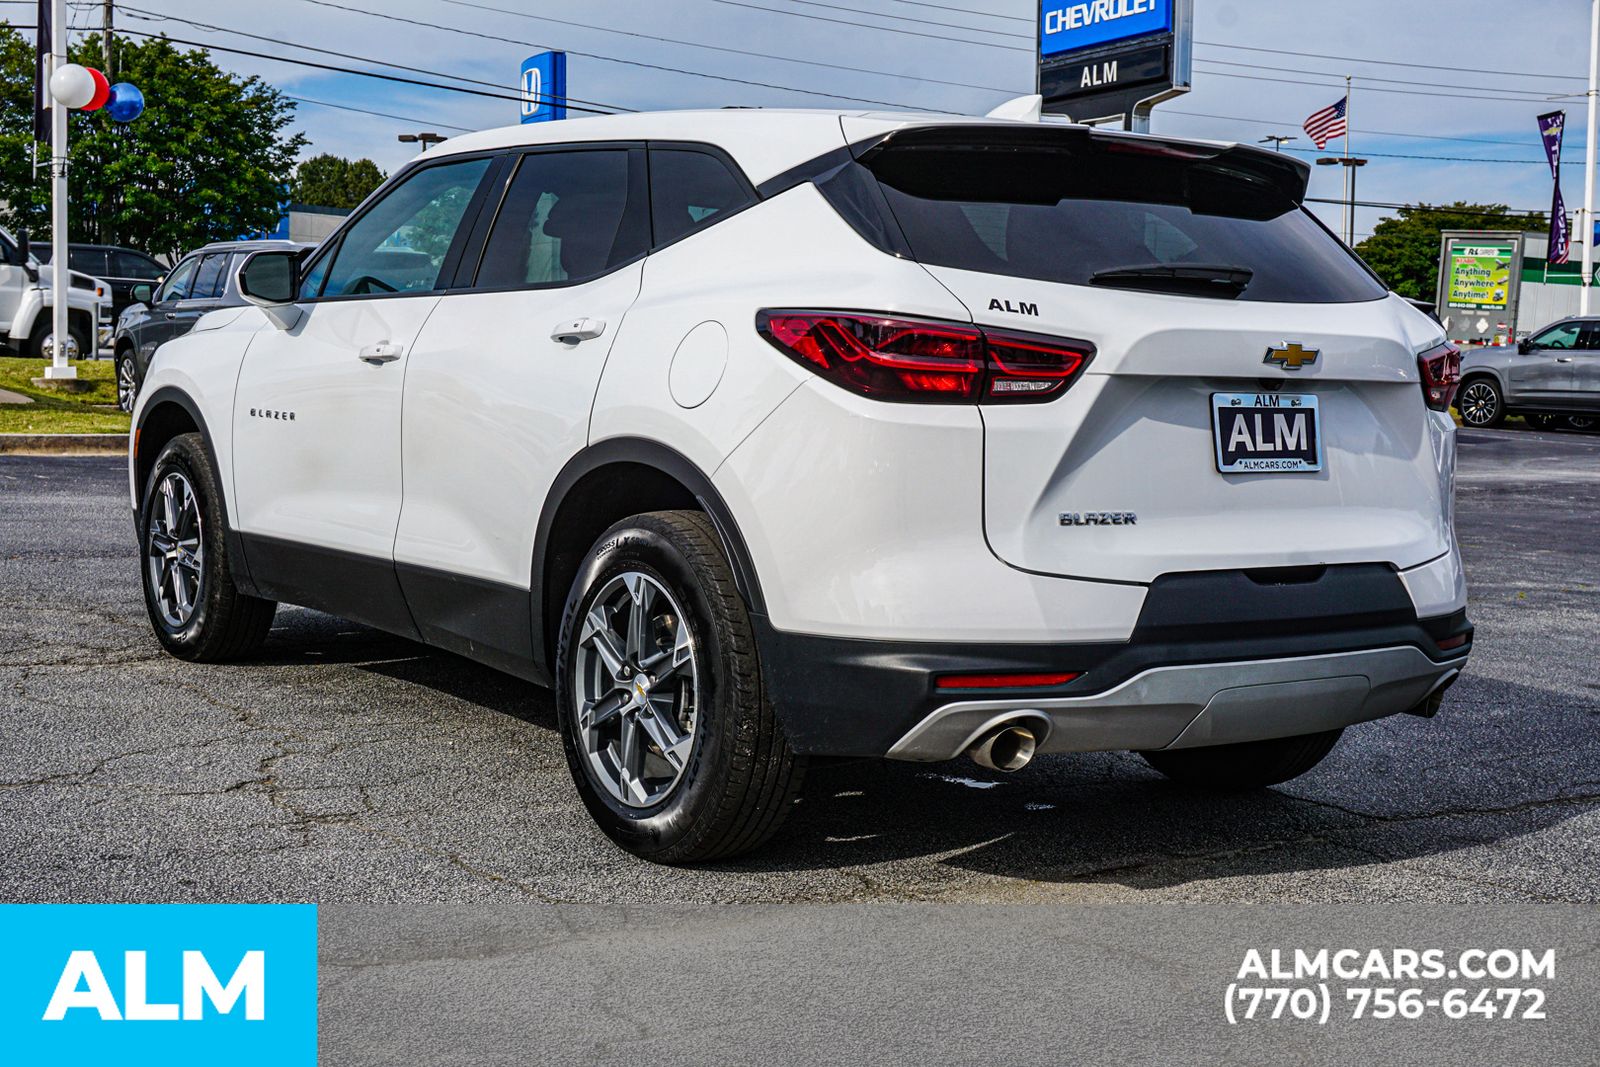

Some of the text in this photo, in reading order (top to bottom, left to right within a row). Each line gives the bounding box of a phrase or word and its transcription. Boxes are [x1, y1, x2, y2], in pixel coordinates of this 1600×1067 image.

[1080, 60, 1118, 88] ALM
[1455, 267, 1491, 277] Anything
[1454, 278, 1495, 288] Anywhere
[1453, 289, 1489, 299] Anytime!
[988, 298, 1039, 317] ALM
[1254, 394, 1280, 407] ALM
[250, 408, 296, 421] BLAZER
[1227, 413, 1308, 452] ALM
[1244, 460, 1299, 470] ALMCARS.COM
[1059, 511, 1138, 526] BLAZER
